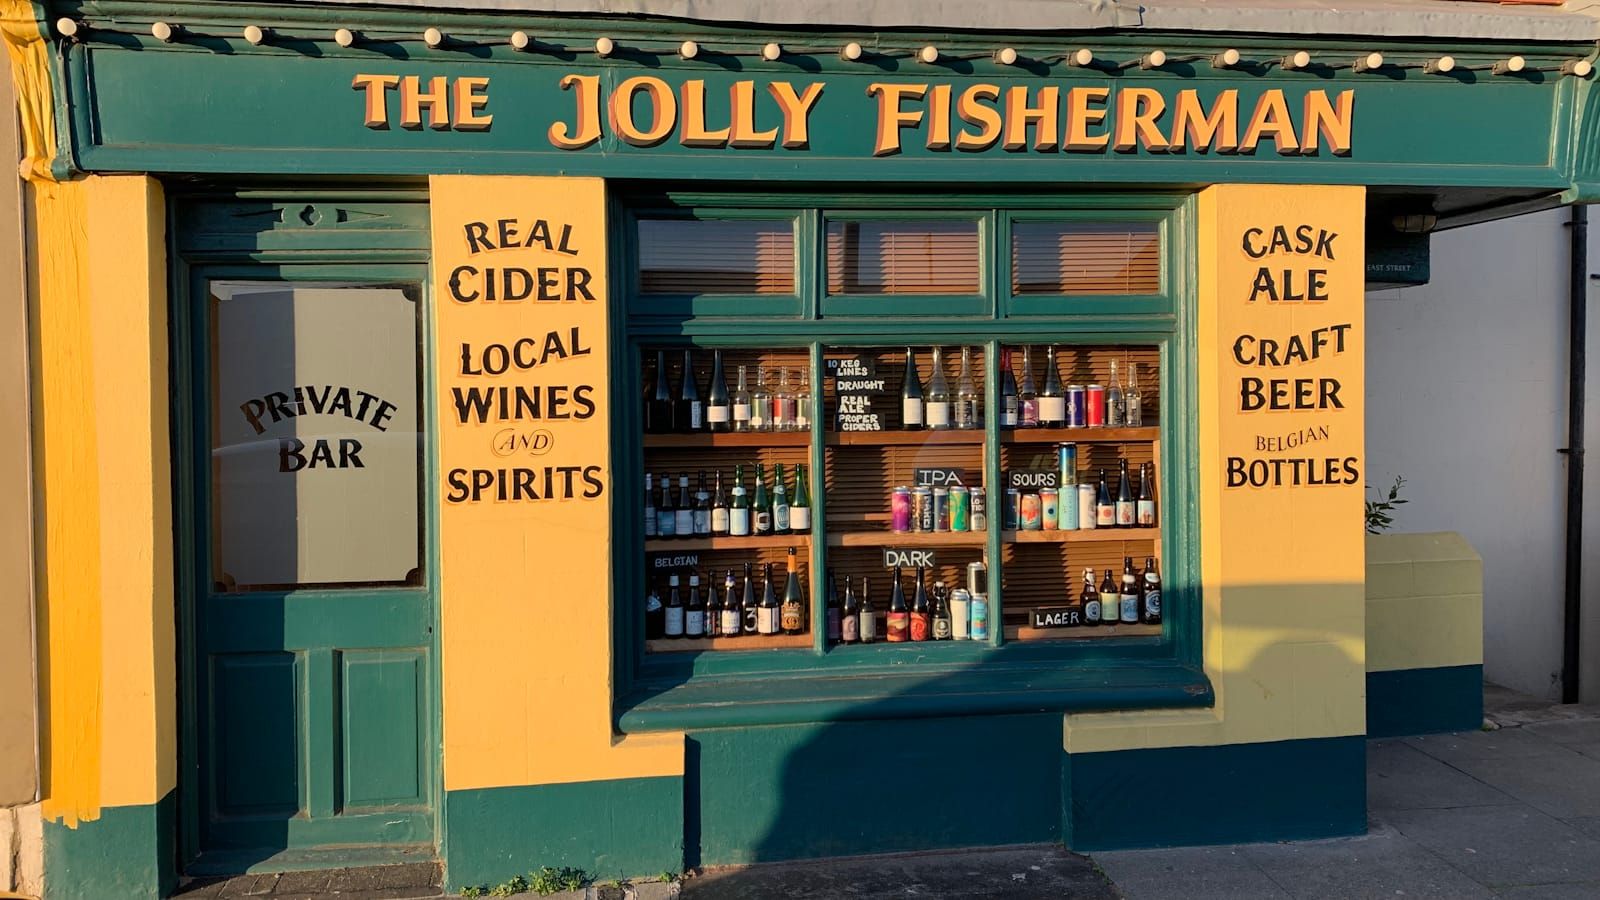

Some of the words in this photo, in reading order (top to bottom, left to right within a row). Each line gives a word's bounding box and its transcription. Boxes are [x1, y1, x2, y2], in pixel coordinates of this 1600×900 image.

[352, 74, 493, 129] THE
[548, 74, 826, 150] JOLLY
[867, 82, 1354, 157] FISHERMAN
[463, 218, 579, 256] REAL
[1242, 224, 1339, 261] CASK
[447, 265, 597, 303] CIDER
[1248, 267, 1329, 302] ALE
[459, 326, 592, 376] LOCAL
[1232, 323, 1352, 367] CRAFT
[828, 360, 837, 369] 10
[840, 359, 861, 369] KEG
[836, 367, 868, 377] LINES
[837, 380, 885, 392] DRAUGHT
[840, 395, 871, 405] REAL
[1241, 377, 1345, 411] BEER
[239, 385, 398, 436] PRIVATE
[451, 384, 597, 424] WINES
[838, 404, 865, 414] ALE
[838, 413, 879, 424] PROPER
[842, 422, 881, 431] CIDERS
[1256, 425, 1330, 452] BELGIAN
[278, 437, 366, 473] BAR
[492, 427, 554, 457] AND
[446, 465, 605, 503] SPIRITS
[919, 470, 963, 486] IPA
[1012, 472, 1056, 487] SOURS
[1226, 456, 1360, 488] BOTTLES
[654, 555, 698, 568] BELGIAN
[885, 550, 934, 568] DARK
[1035, 611, 1080, 626] LAGER
